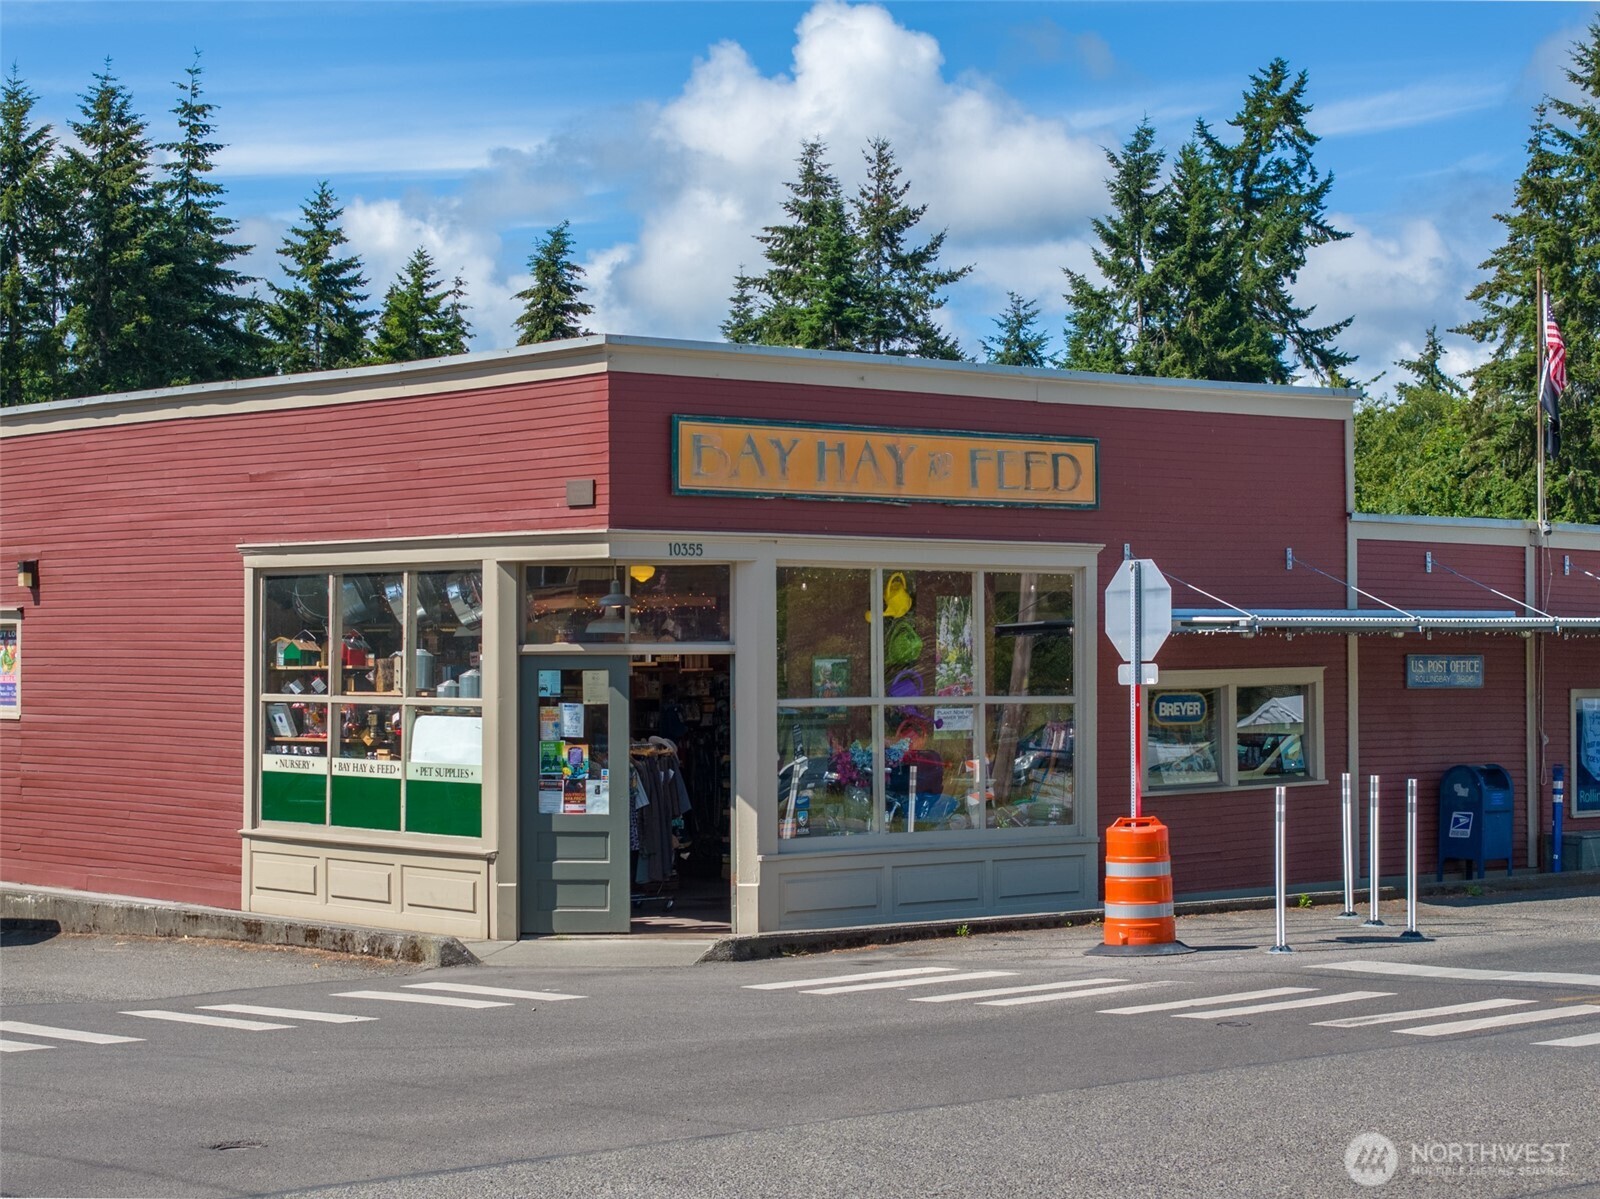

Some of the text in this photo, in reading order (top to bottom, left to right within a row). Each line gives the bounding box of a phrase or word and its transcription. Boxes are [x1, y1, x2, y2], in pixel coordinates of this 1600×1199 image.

[691, 433, 799, 481] BAY
[816, 439, 918, 486] HAY
[968, 448, 1083, 492] FEED
[668, 543, 703, 556] 10355
[1411, 660, 1480, 673] U.S. POST OFFICE
[1159, 702, 1201, 716] BREYER
[279, 759, 310, 770] NURSERY
[338, 762, 396, 774] BAY HAY & FEED
[420, 766, 469, 778] PET SUPPLIES
